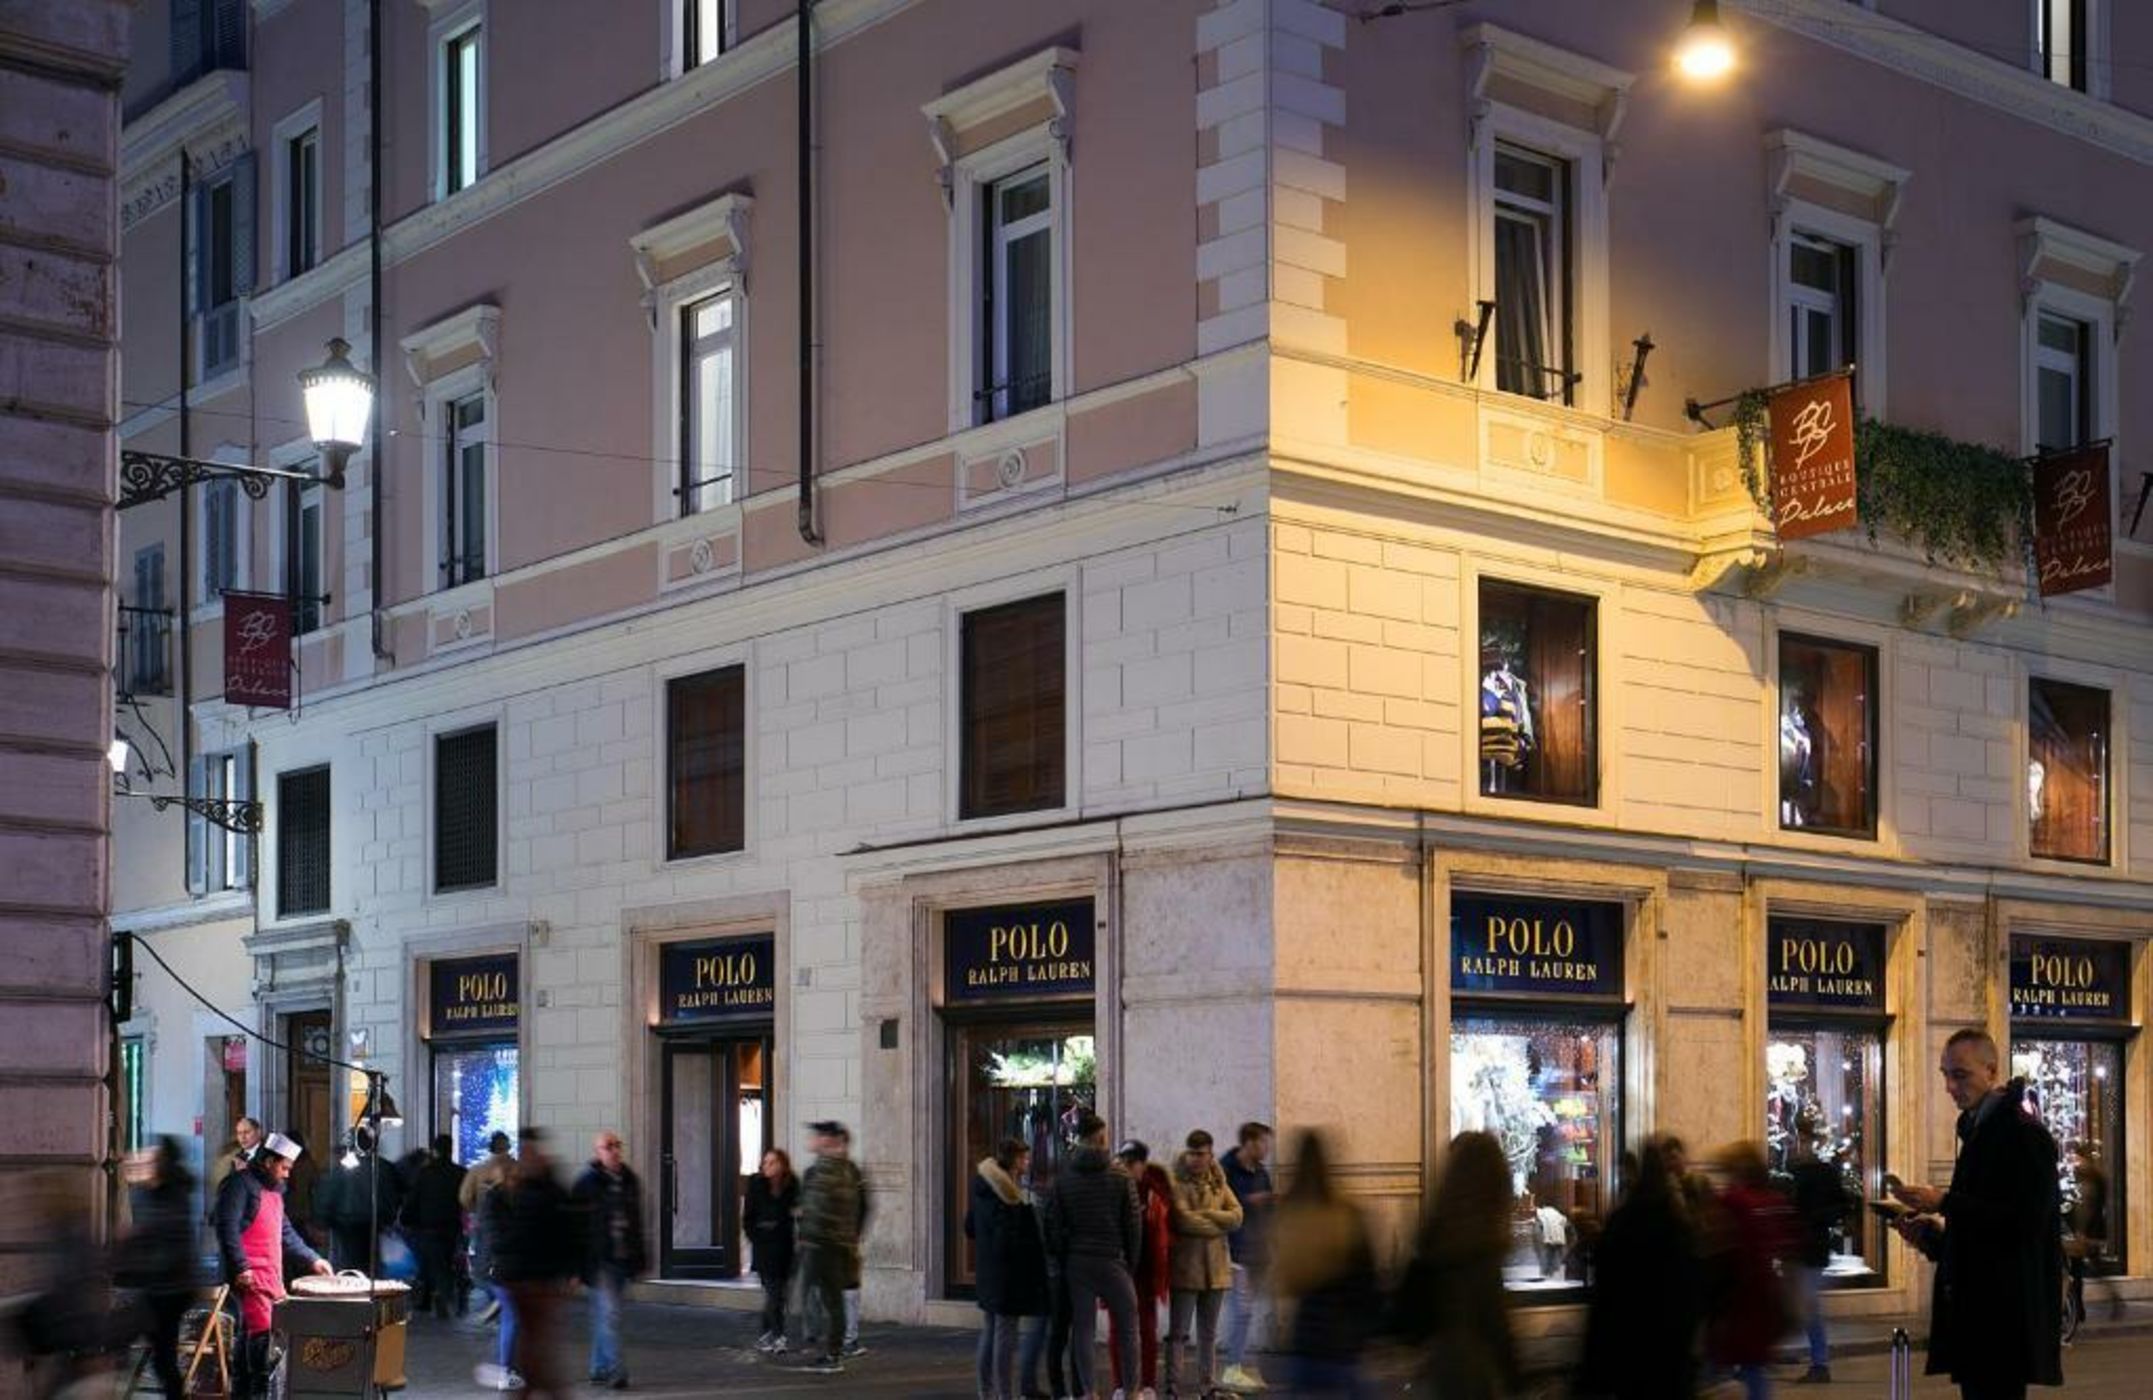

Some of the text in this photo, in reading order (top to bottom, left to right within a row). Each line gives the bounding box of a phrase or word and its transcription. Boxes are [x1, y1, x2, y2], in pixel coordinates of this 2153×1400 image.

[1780, 459, 1850, 486] BOUTIQUE
[991, 921, 1069, 962] POLO
[1487, 916, 1574, 958] POLO
[1461, 956, 1597, 981] RALPH LAUREN
[1782, 938, 1854, 974] POLO
[697, 953, 756, 989] POLO
[968, 961, 1091, 985] RALPH LAUREN
[2032, 954, 2094, 988] POLO
[460, 973, 507, 1002] POLO
[678, 987, 773, 1008] RALPH LAUREN
[1767, 976, 1873, 996] ALPH LAUREN
[2013, 987, 2110, 1006] RALPH LAUREN
